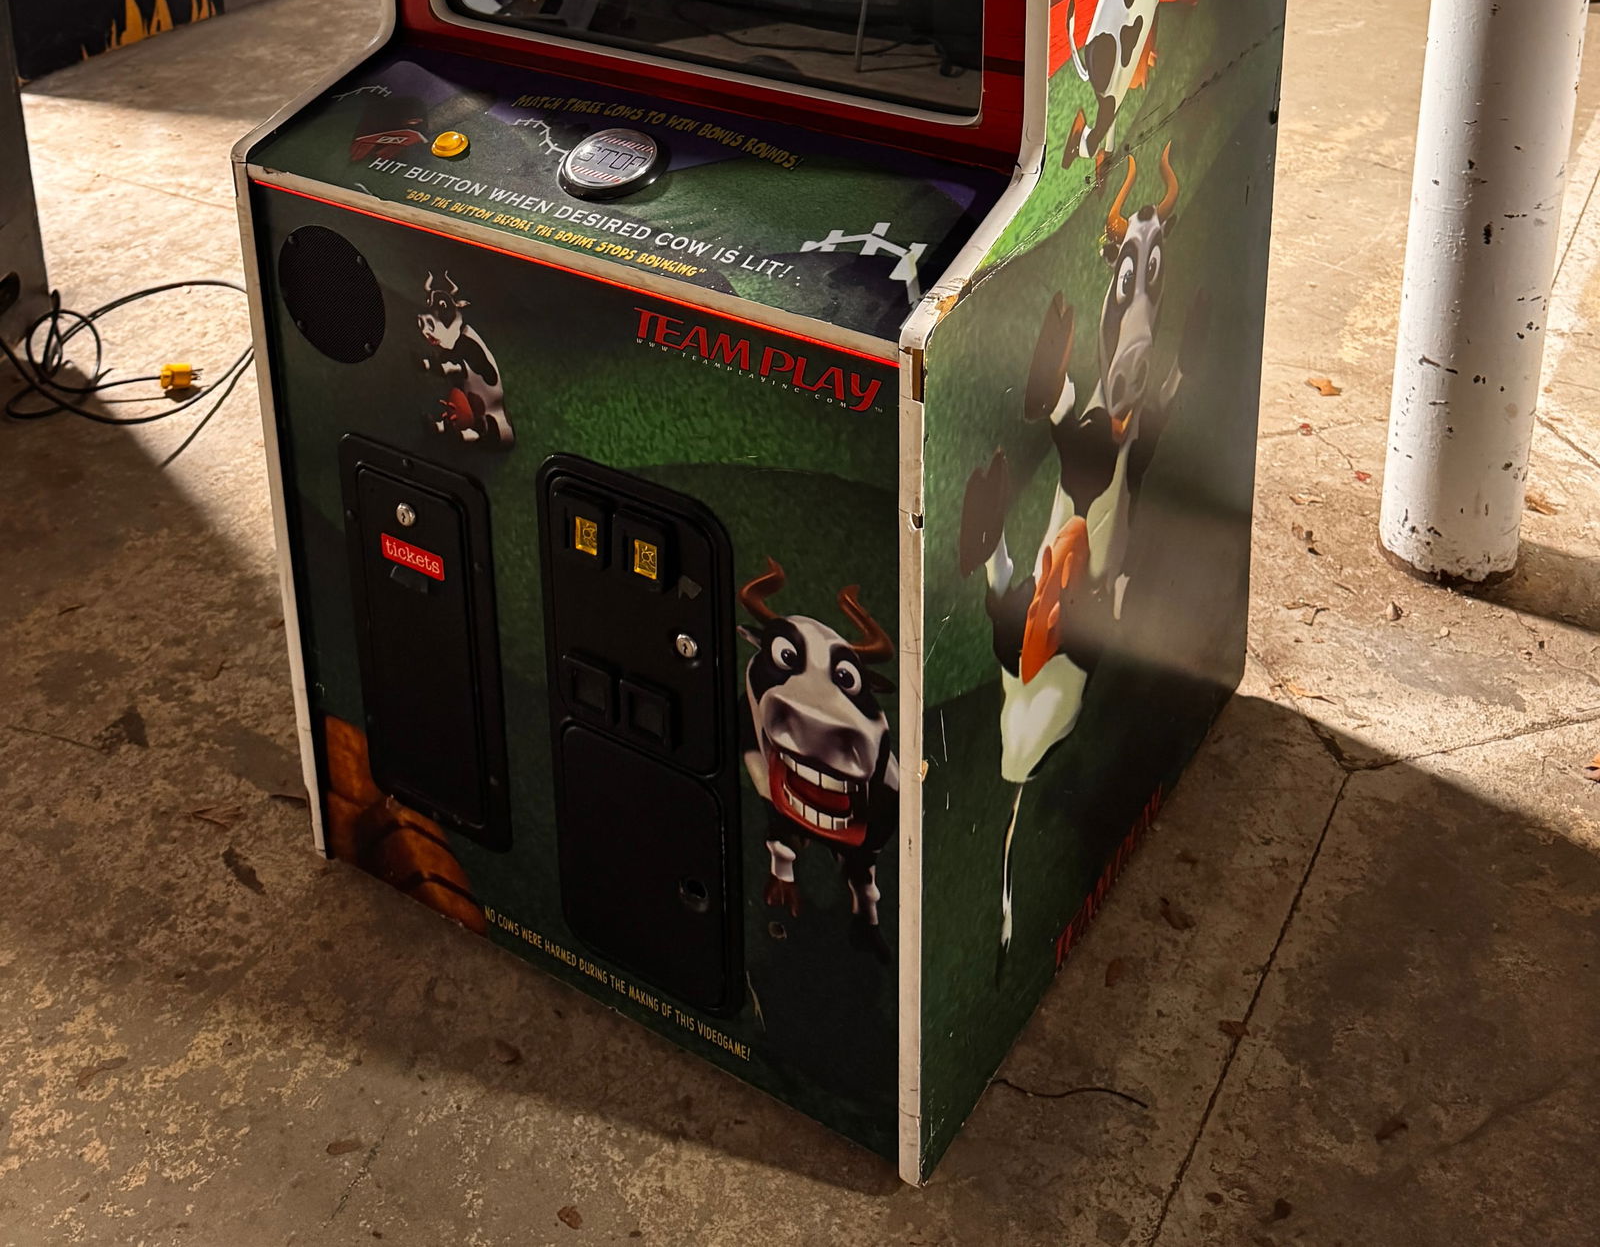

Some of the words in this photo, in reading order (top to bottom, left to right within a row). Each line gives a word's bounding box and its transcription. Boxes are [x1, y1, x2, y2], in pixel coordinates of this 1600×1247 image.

[511, 94, 561, 110] MATCH
[562, 97, 605, 114] THREE
[603, 103, 645, 121] COWS
[643, 111, 667, 125] TO
[665, 114, 701, 133] WIN
[697, 123, 746, 147] BONUS
[743, 137, 804, 171] ROUNDS!
[576, 143, 648, 172] STOP
[368, 157, 408, 174] HIT
[403, 166, 488, 197] BUTTON
[487, 187, 556, 214] WHEN
[553, 205, 653, 241] DESIRED
[653, 232, 713, 257] COW
[711, 247, 742, 264] IS
[739, 254, 796, 279] LIT!
[431, 196, 452, 209] THE
[451, 202, 496, 221] BUTTON
[492, 214, 535, 232] BEFORE
[534, 224, 556, 238] THE
[594, 241, 637, 261] STOPS
[634, 307, 749, 371] TEAM
[759, 346, 882, 412] PLAY
[385, 539, 440, 574] tickets
[485, 905, 496, 923] NO
[497, 913, 520, 936] COWS
[521, 926, 543, 949] WERE
[544, 939, 577, 967] HARMED
[579, 958, 608, 984] DURING
[609, 974, 626, 995] THE
[628, 984, 659, 1011] MAKING
[661, 1000, 673, 1018] OF
[675, 1008, 695, 1032] THIS
[697, 1019, 751, 1062] VIDEOGAME!
